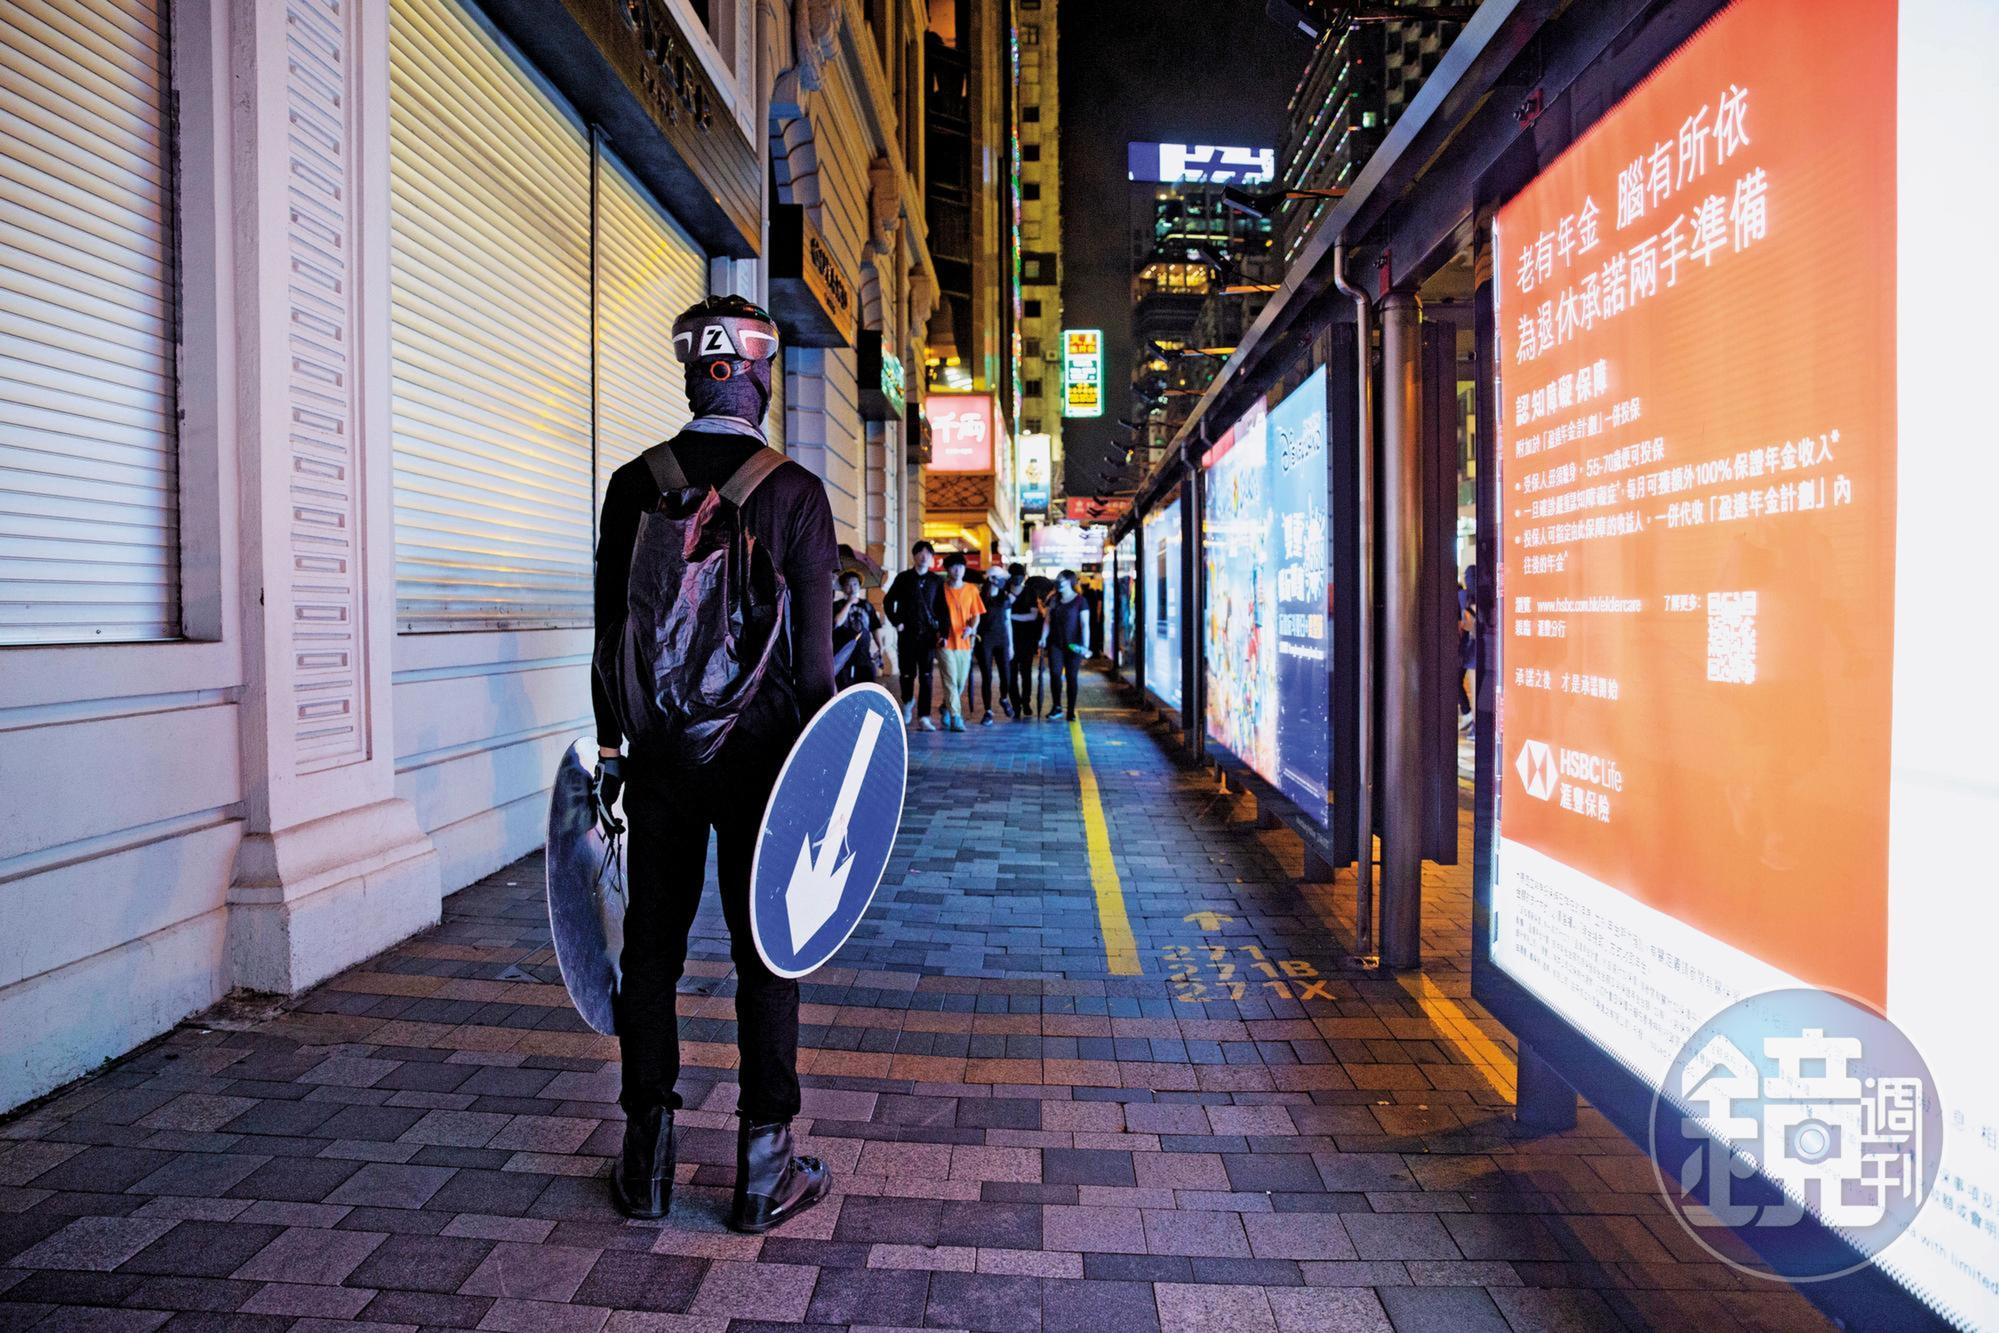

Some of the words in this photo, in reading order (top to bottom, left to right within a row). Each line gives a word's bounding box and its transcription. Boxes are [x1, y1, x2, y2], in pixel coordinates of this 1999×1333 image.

[1516, 196, 1600, 295] 老有年金
[1616, 84, 1749, 231] 腦有所依
[1516, 167, 1769, 365] 為退休承諾兩手準備
[1560, 747, 1600, 784] HSBC
[1601, 758, 1623, 792] Life
[1162, 945, 1265, 961] 271
[1167, 960, 1319, 982] 271B
[1174, 980, 1337, 1003] 271X
